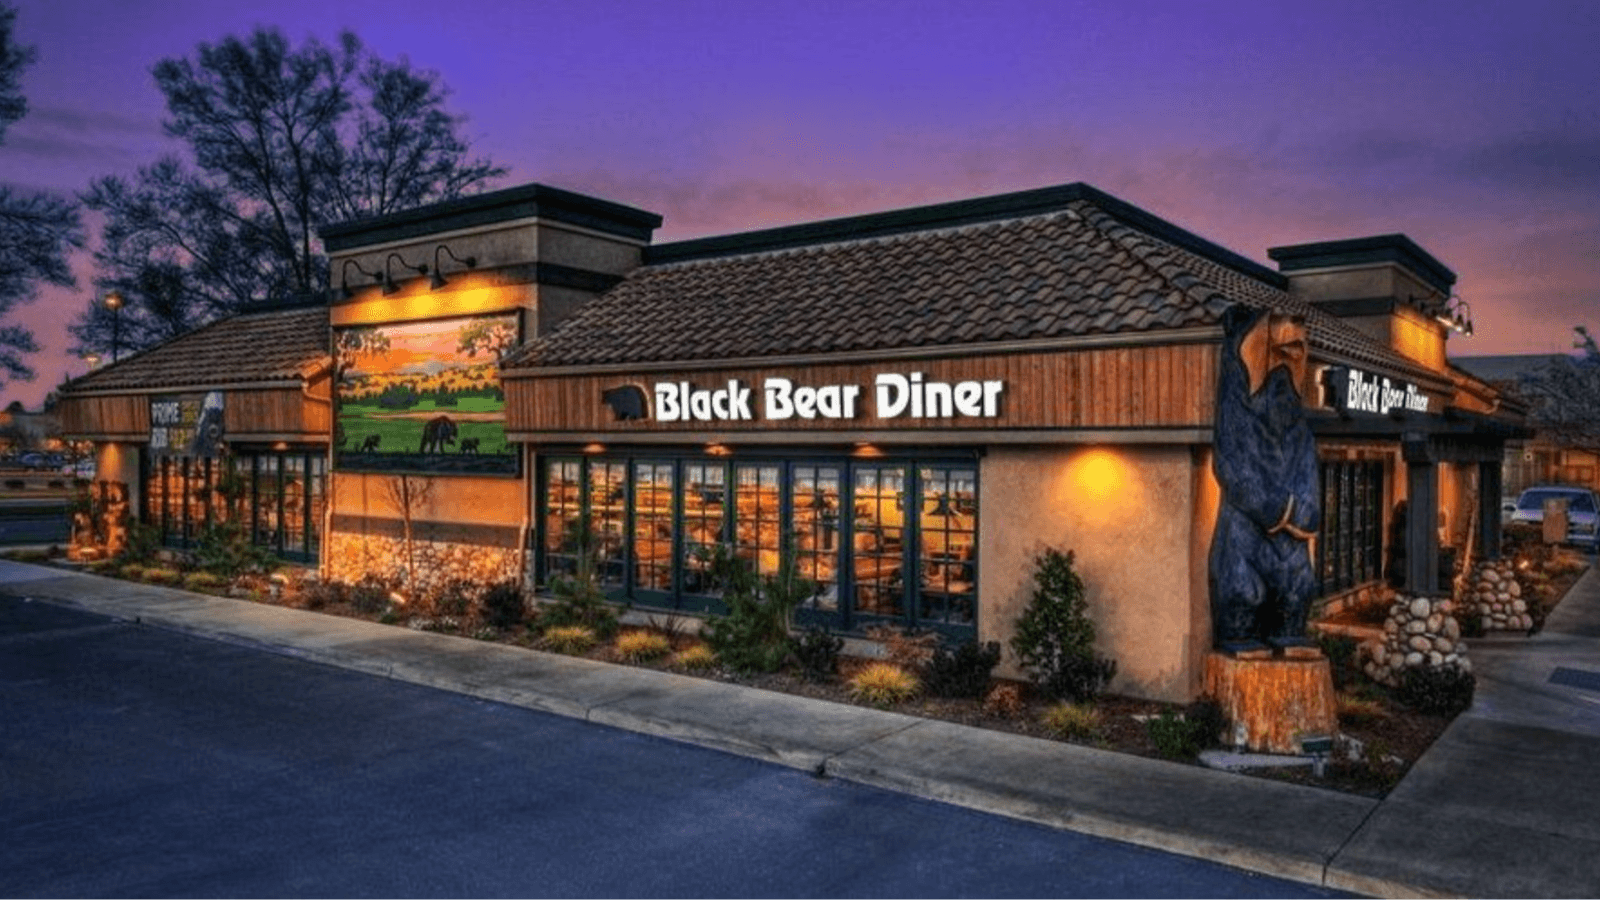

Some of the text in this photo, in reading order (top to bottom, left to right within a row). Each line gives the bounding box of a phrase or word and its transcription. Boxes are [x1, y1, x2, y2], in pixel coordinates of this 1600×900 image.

[655, 372, 1003, 421] Black Bear Diner
[1348, 370, 1379, 412] Black
